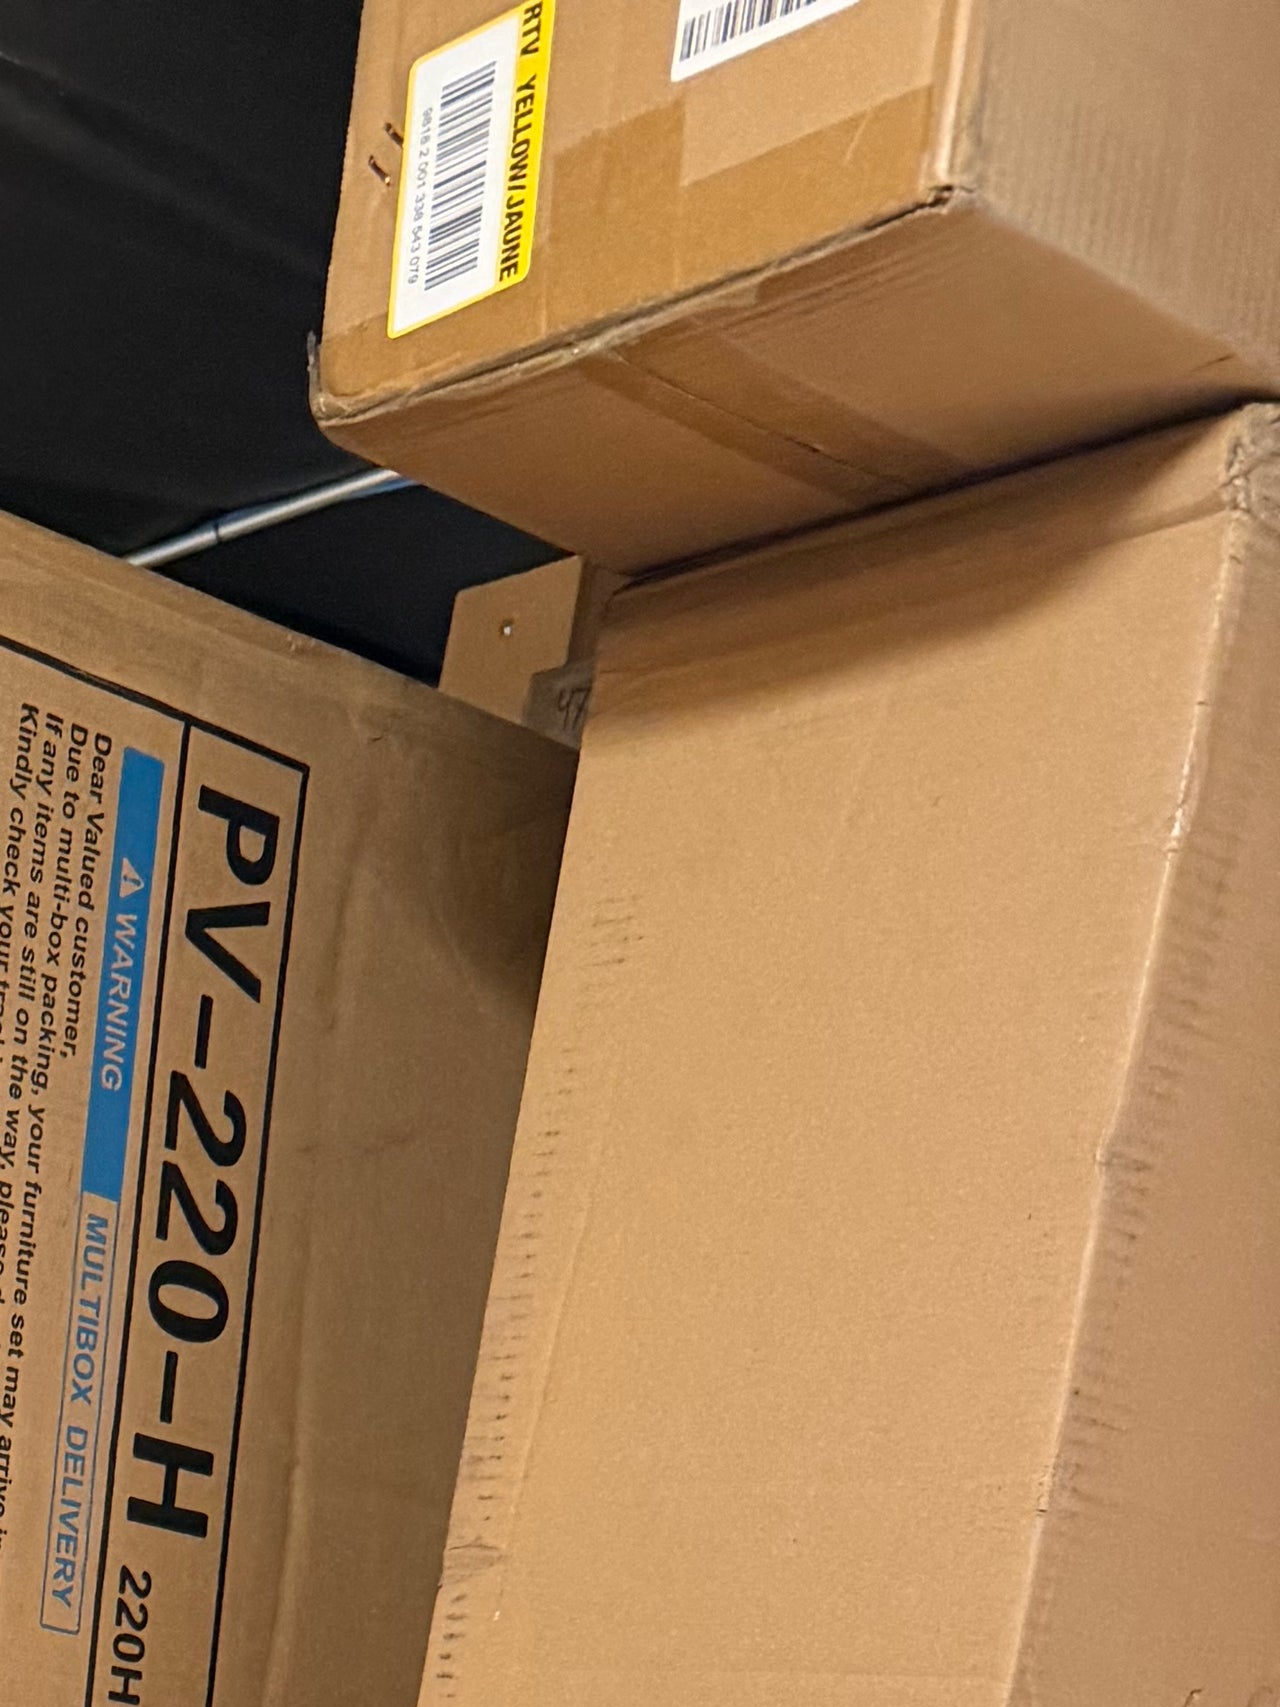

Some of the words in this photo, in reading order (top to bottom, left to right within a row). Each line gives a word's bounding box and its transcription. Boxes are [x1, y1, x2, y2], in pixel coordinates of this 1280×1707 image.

[520, 3, 542, 57] RTV
[499, 74, 536, 282] YELLOW/JAUNE
[44, 711, 64, 739] If
[65, 721, 89, 783] Due
[34, 739, 57, 797] any
[61, 789, 80, 820] to
[88, 731, 113, 805] Dear
[28, 801, 55, 884] items
[76, 811, 105, 912] Valued
[23, 890, 41, 939] are
[45, 826, 73, 967] multi-box
[17, 944, 37, 1002] still
[58, 915, 89, 1059] customer,
[100, 910, 139, 1093] WARNING
[12, 1006, 30, 1046] on
[29, 971, 58, 1096] packing,
[7, 1053, 29, 1100] the
[26, 1102, 46, 1175] your
[126, 784, 281, 1540] PV-220-H
[12, 1179, 43, 1305] furniture
[6, 1311, 25, 1359] set
[70, 1212, 109, 1404] MULTIBOX
[51, 1426, 88, 1608] DELIVERY
